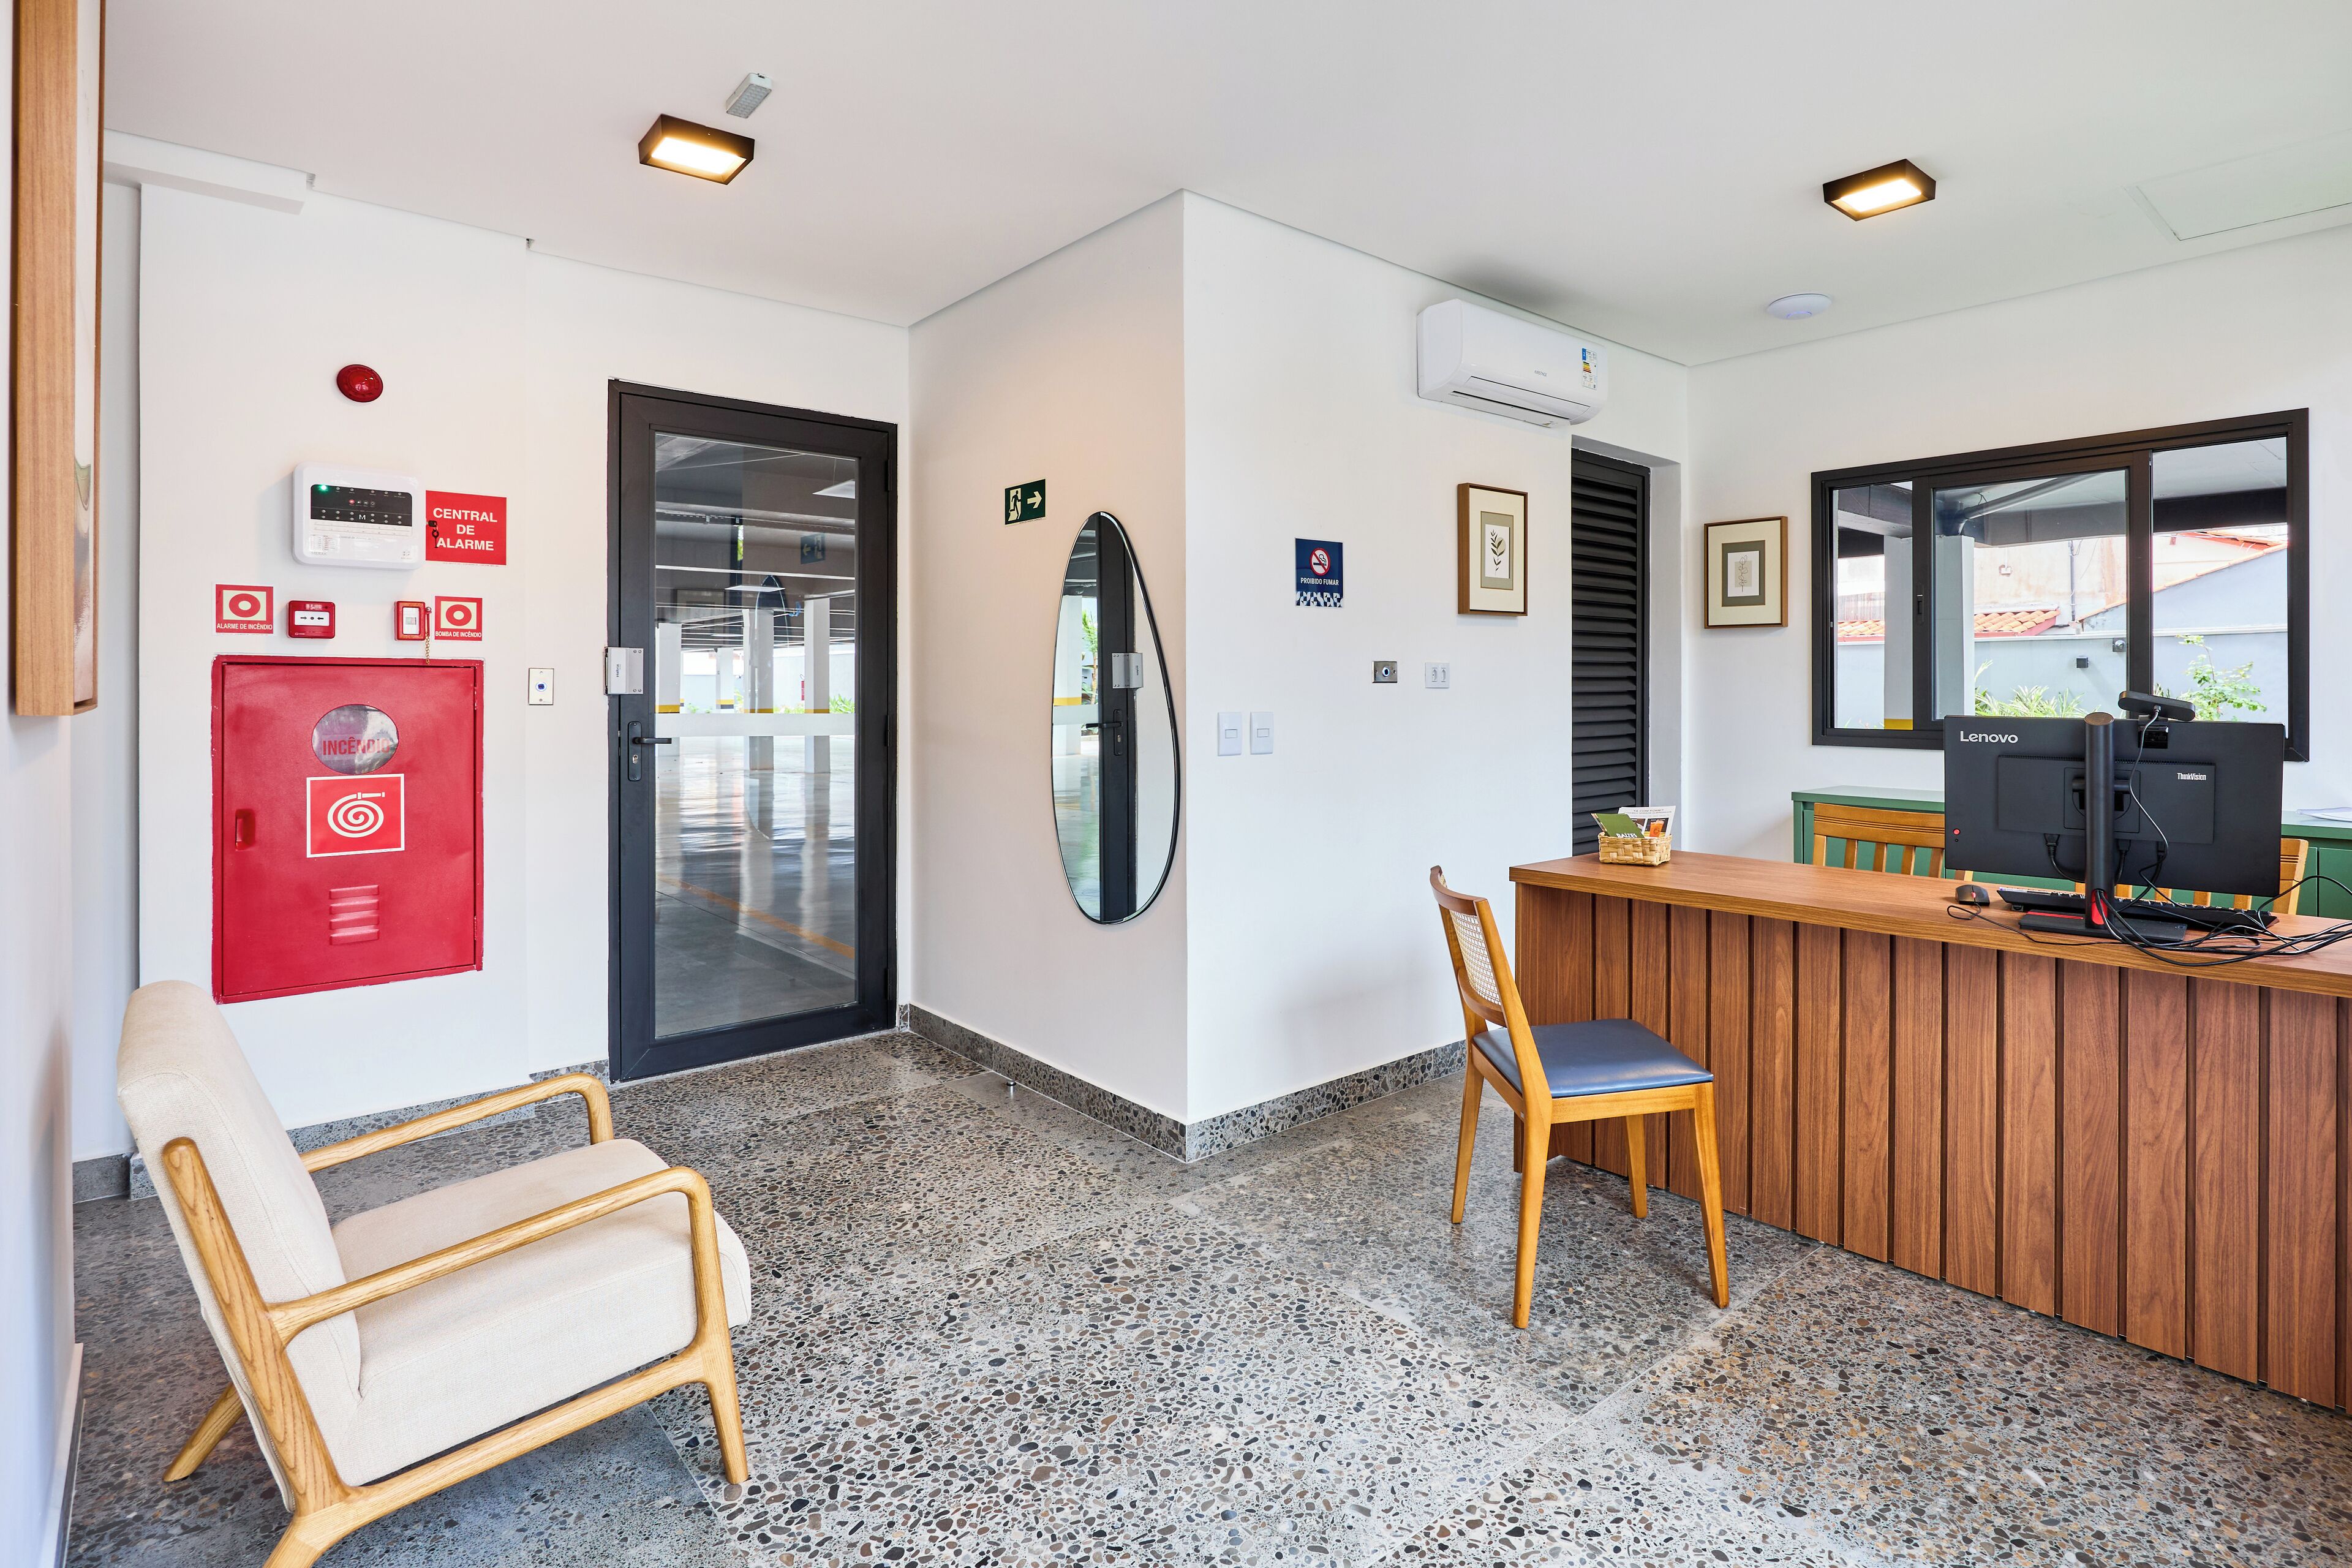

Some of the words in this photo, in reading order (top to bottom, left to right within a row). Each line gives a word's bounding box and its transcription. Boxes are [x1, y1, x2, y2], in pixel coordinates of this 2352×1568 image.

[433, 507, 498, 522] CENTRAL
[456, 524, 475, 535] DE
[436, 537, 494, 551] ALARME
[1960, 731, 2019, 744] Lenovo
[322, 736, 391, 756] INCÊNDIO
[2177, 772, 2207, 781] ThinkVision
